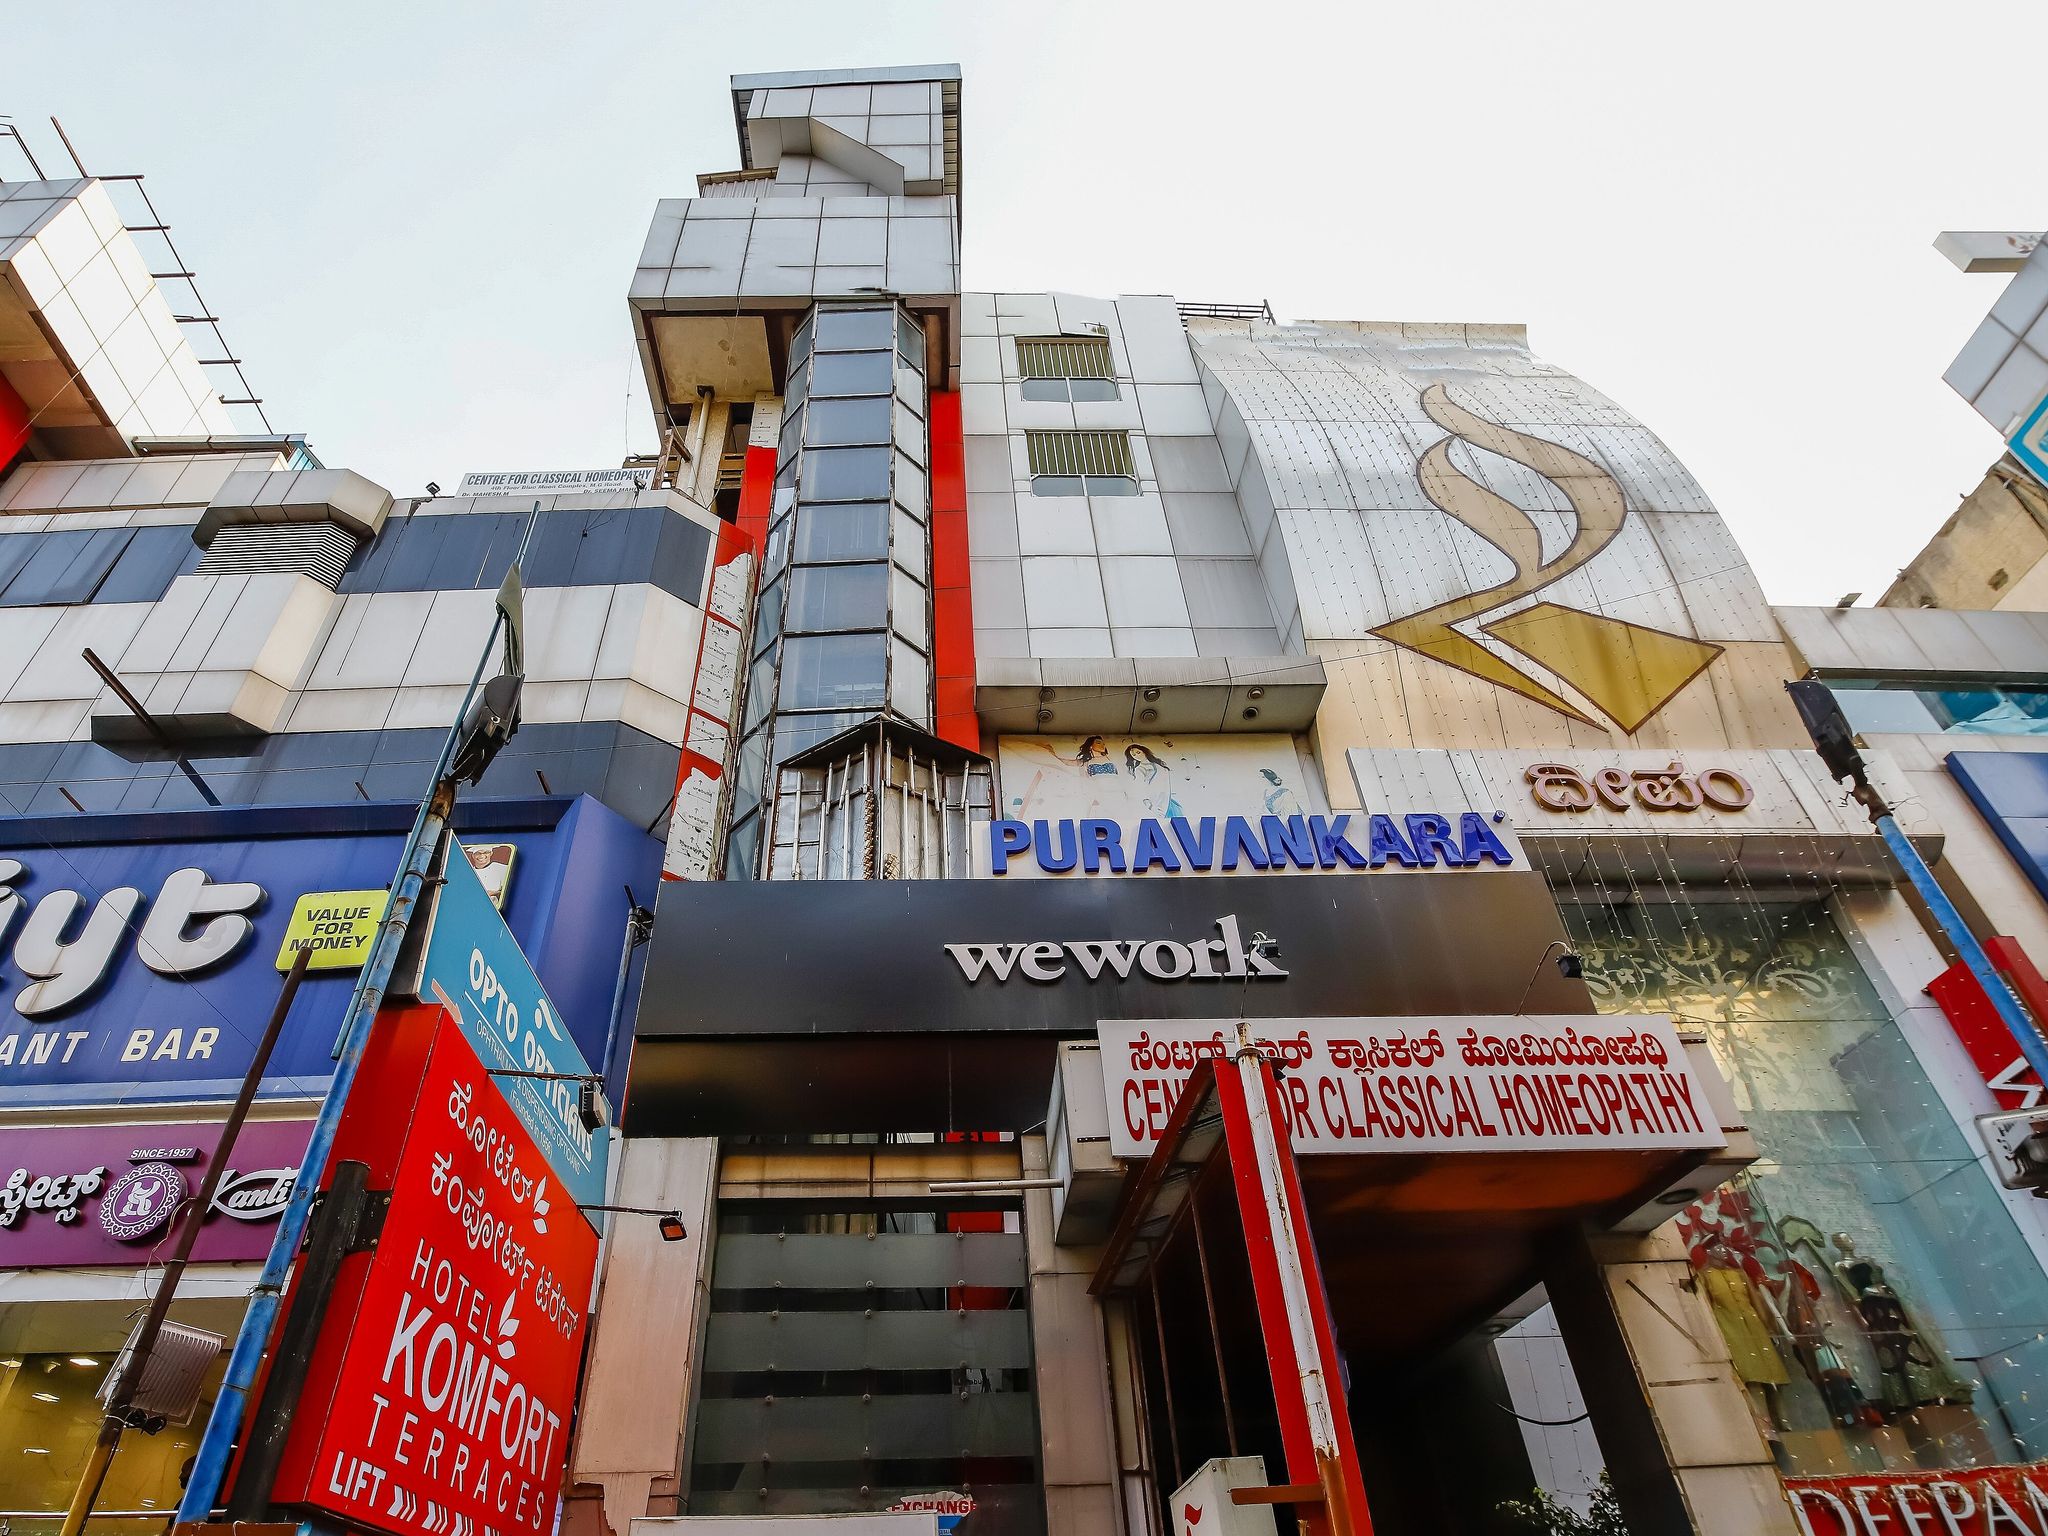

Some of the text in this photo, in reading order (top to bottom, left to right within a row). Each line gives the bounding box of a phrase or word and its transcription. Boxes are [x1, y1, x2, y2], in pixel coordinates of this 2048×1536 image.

[468, 469, 651, 486] CENTRE FOR CLASSICAL HOMEOPATHY
[990, 813, 1513, 875] PURAVANKARA
[289, 936, 368, 951] MONEY
[307, 907, 371, 921] VALUE
[312, 922, 353, 935] FOR
[944, 914, 1289, 983] wework
[469, 948, 518, 1042] OPTO
[120, 1027, 220, 1063] BAR
[1318, 1074, 1498, 1140] CLASSICAL
[1488, 1072, 1704, 1137] HOMEOPATHY
[130, 1148, 193, 1159] SINCE-1957
[410, 1238, 493, 1345] HOTEL
[382, 1291, 561, 1482] KOMFORT
[329, 1450, 387, 1507] LIFT
[367, 1393, 545, 1530] TERRACES
